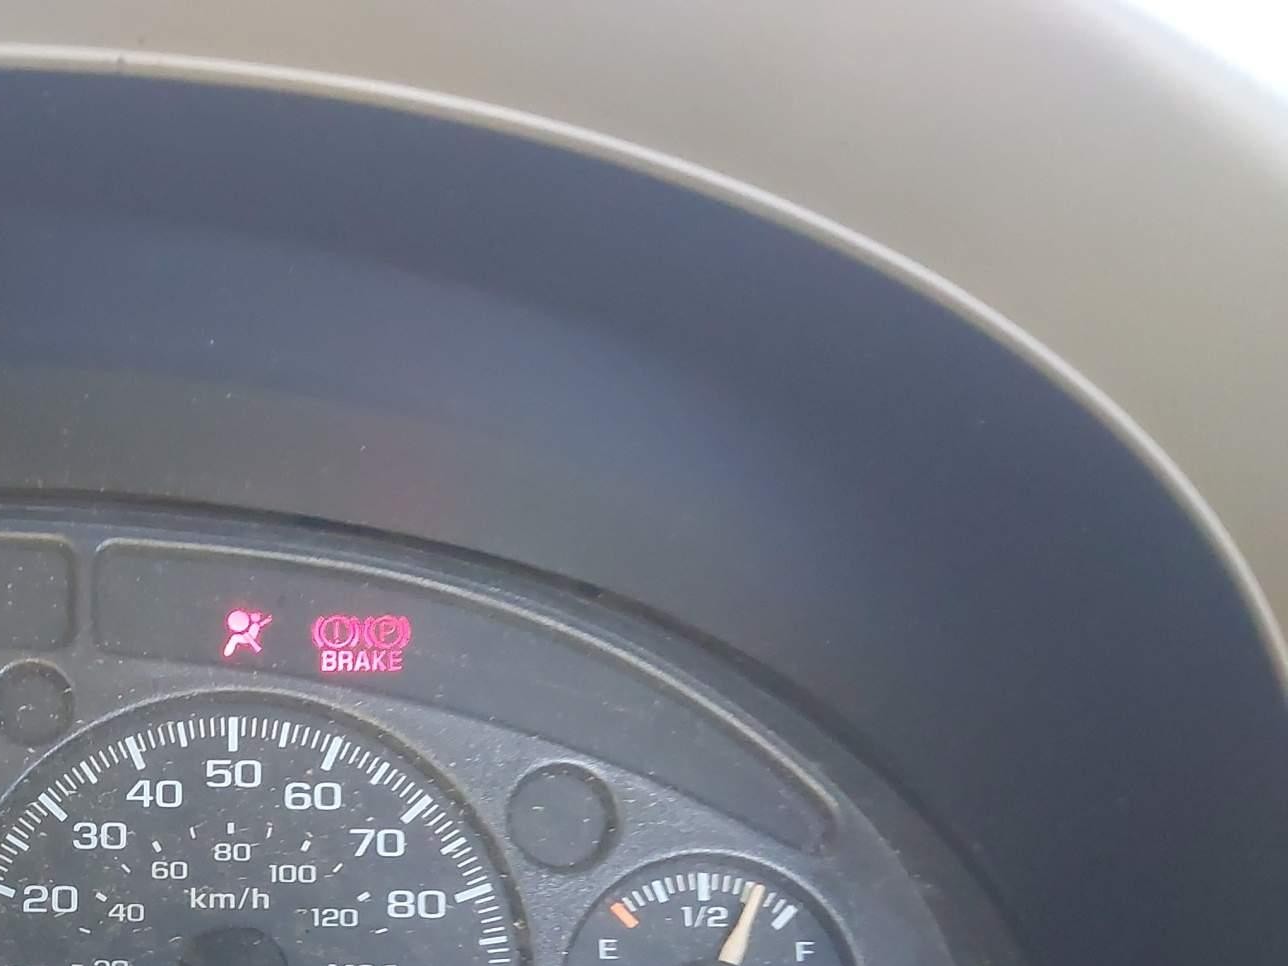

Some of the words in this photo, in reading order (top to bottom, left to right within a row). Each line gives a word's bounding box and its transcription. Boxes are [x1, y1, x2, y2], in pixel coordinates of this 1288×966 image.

[321, 649, 403, 672] BRAKE
[205, 759, 262, 788] 50
[126, 780, 183, 808] 40
[283, 782, 342, 811] 60
[72, 822, 127, 850] 30
[348, 829, 405, 857] 70
[213, 843, 251, 862] 80
[151, 861, 188, 880] 60
[268, 864, 317, 883] 100
[22, 885, 78, 913] 20
[189, 887, 270, 911] km/h
[386, 890, 446, 919] 80
[108, 903, 145, 923] 40
[311, 908, 359, 927] 120
[681, 906, 729, 928] 1/2
[598, 939, 619, 960] E
[795, 941, 816, 962] F
